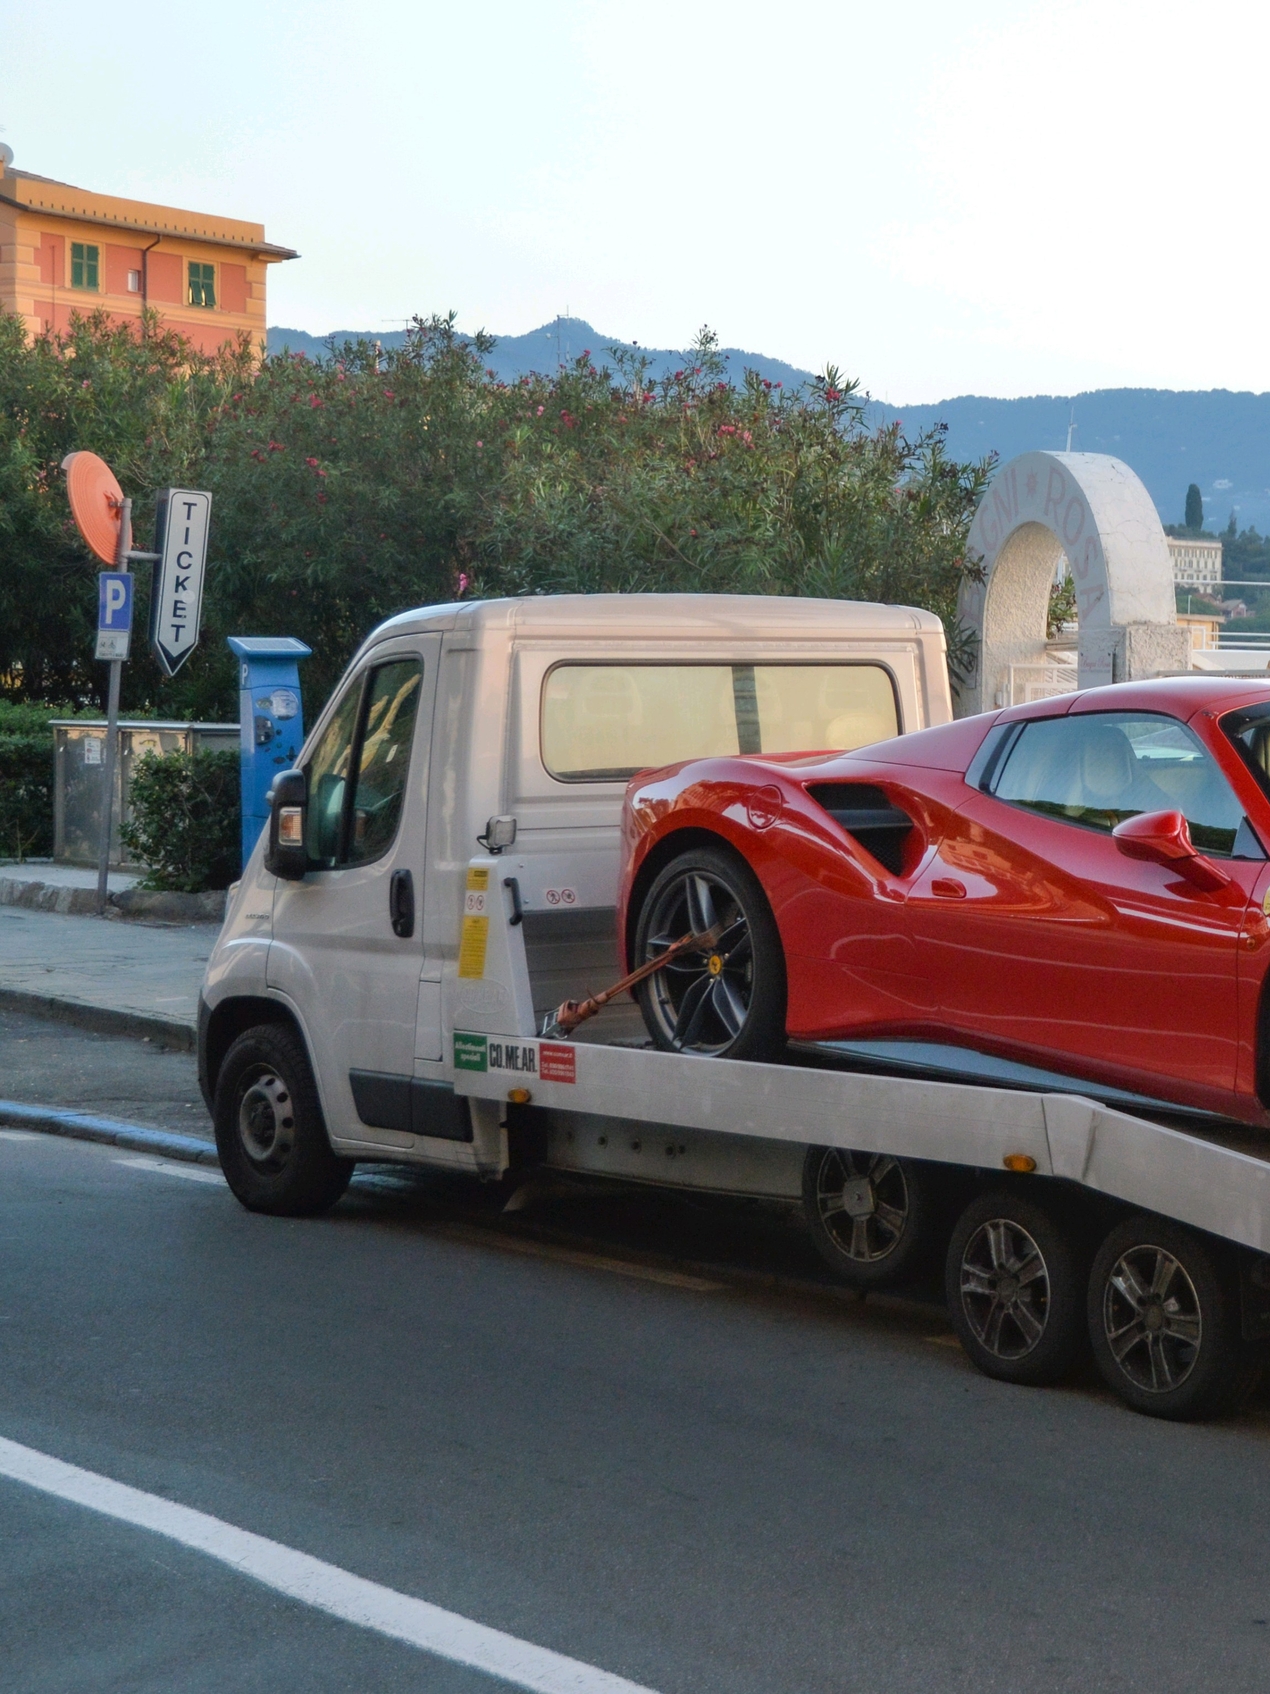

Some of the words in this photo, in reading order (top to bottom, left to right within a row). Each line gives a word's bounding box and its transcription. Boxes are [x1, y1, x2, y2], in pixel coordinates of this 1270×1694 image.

[170, 502, 198, 643] TICKET
[1044, 465, 1104, 620] ROSA
[105, 580, 126, 624] P
[242, 663, 249, 685] P
